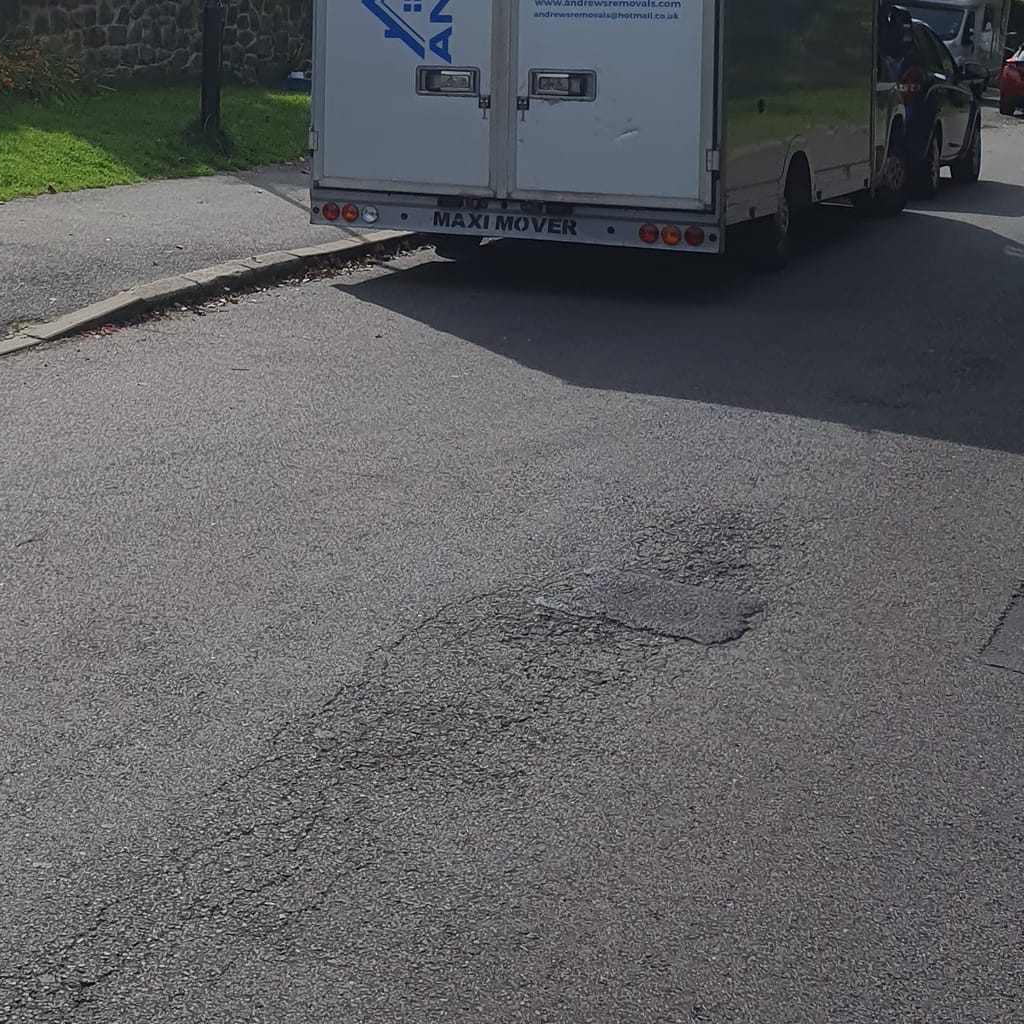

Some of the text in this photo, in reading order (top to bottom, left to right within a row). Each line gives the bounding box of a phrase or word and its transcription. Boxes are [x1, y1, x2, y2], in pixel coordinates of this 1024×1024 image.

[533, 11, 679, 20] andrewsremovals@hotmail.co.uk
[433, 211, 577, 236] MAXI MOVER
